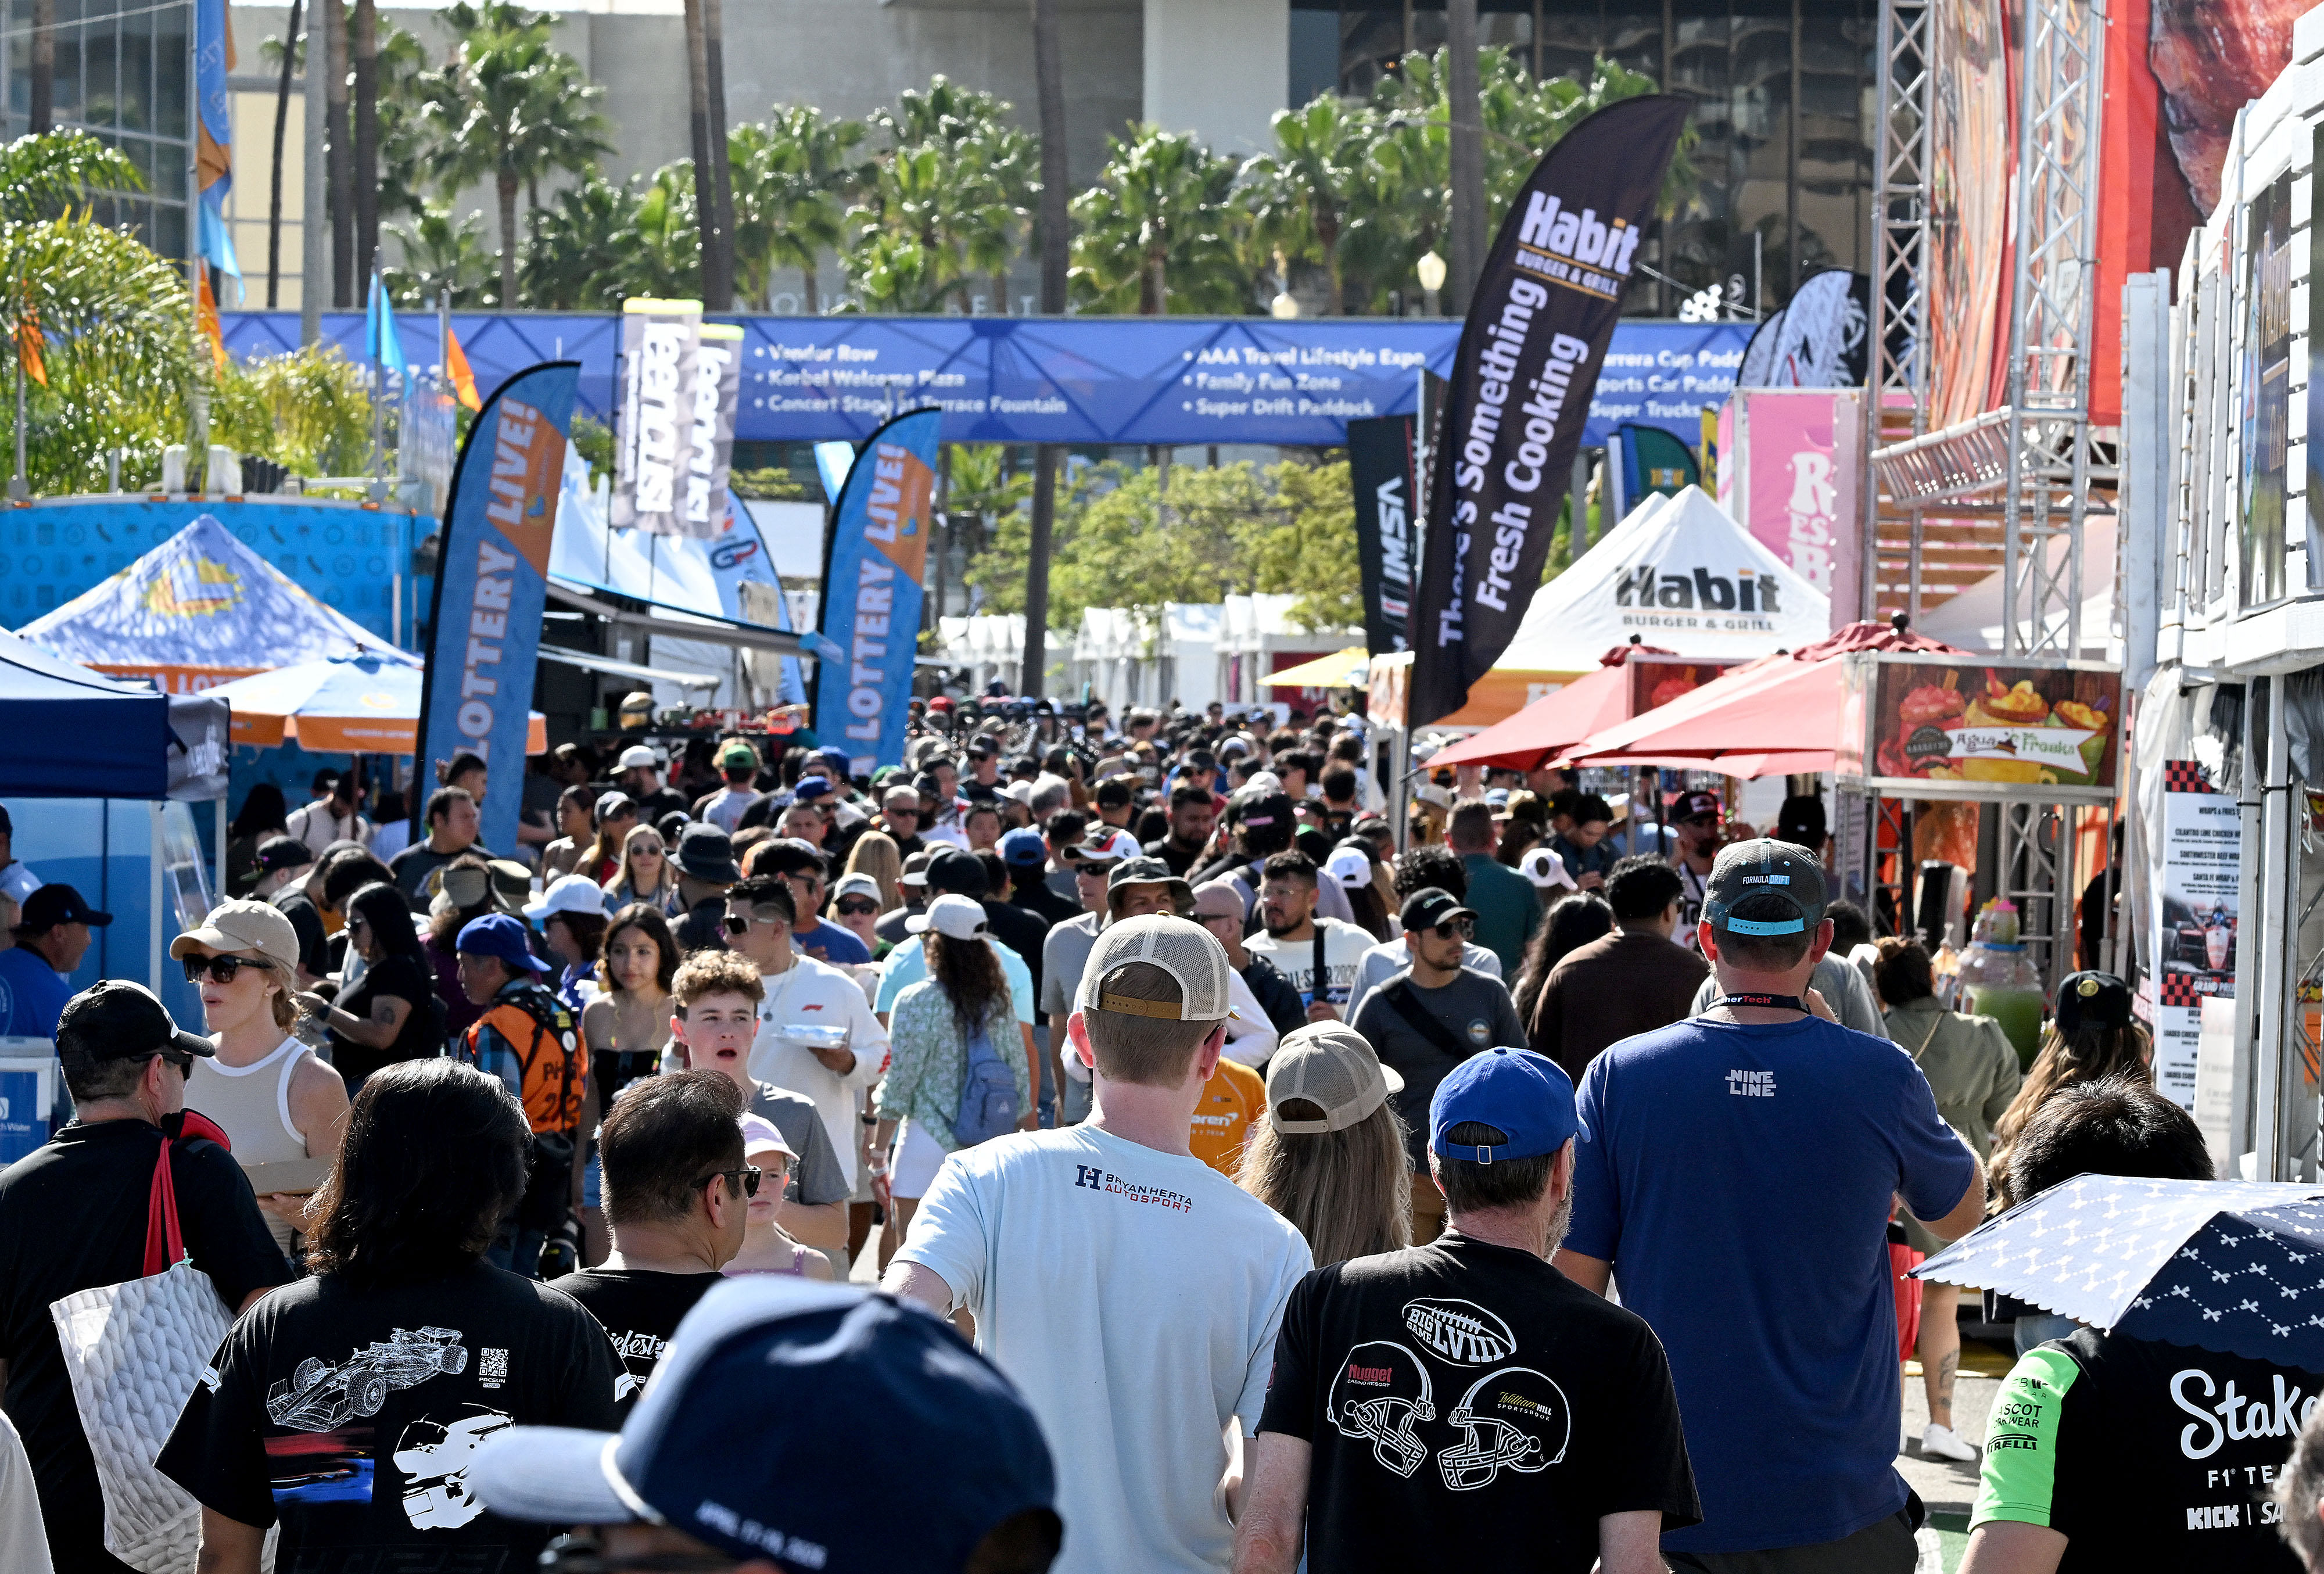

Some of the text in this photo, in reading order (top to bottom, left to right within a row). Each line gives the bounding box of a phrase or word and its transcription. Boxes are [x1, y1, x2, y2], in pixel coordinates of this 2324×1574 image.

[1519, 190, 1639, 275] Habit
[1514, 249, 1569, 281] BURGER
[1582, 270, 1619, 297] GRILL
[769, 343, 878, 363] Vendor Row
[1196, 346, 1426, 371] AAA Travel Lifestyle Expo
[1602, 349, 1744, 371] arrera Cup Padd
[768, 367, 966, 388] Korbel Welcome Plaza
[1196, 372, 1341, 395] Family Fun Zone
[1455, 278, 1548, 494] Something
[1595, 375, 1645, 396] ports
[1647, 374, 1680, 393] Car
[768, 393, 838, 413] Concert
[990, 395, 1068, 415] Fountain
[1196, 397, 1375, 419] Super Drift Paddock
[1589, 400, 1702, 422] Super Trucks
[486, 396, 539, 525] LIVE!
[1475, 333, 1589, 612] Fresh Cooking
[864, 443, 908, 543] LIVE!
[1376, 475, 1411, 585] IMSA
[1615, 564, 1781, 613] Habit
[1623, 615, 1774, 631] BURGER & GRILL
[453, 540, 518, 762] LOTTERY
[846, 558, 896, 740] LOTTERY
[1742, 875, 1789, 885] FORMULA DRIFT
[1725, 1069, 1773, 1084] NINE
[1730, 1081, 1777, 1097] LINE
[1104, 1183, 1191, 1214] AUTOSPORT
[1408, 1308, 1434, 1332] BIG
[1406, 1321, 1432, 1344] GAME
[1433, 1318, 1505, 1363] LVIII
[1348, 1364, 1393, 1382] Nugget
[1497, 1403, 1550, 1421] SPORTSBOOK
[1499, 1392, 1552, 1415] William HILL
[1998, 1403, 2043, 1418] ASCOT
[2186, 1504, 2239, 1530] KICK
